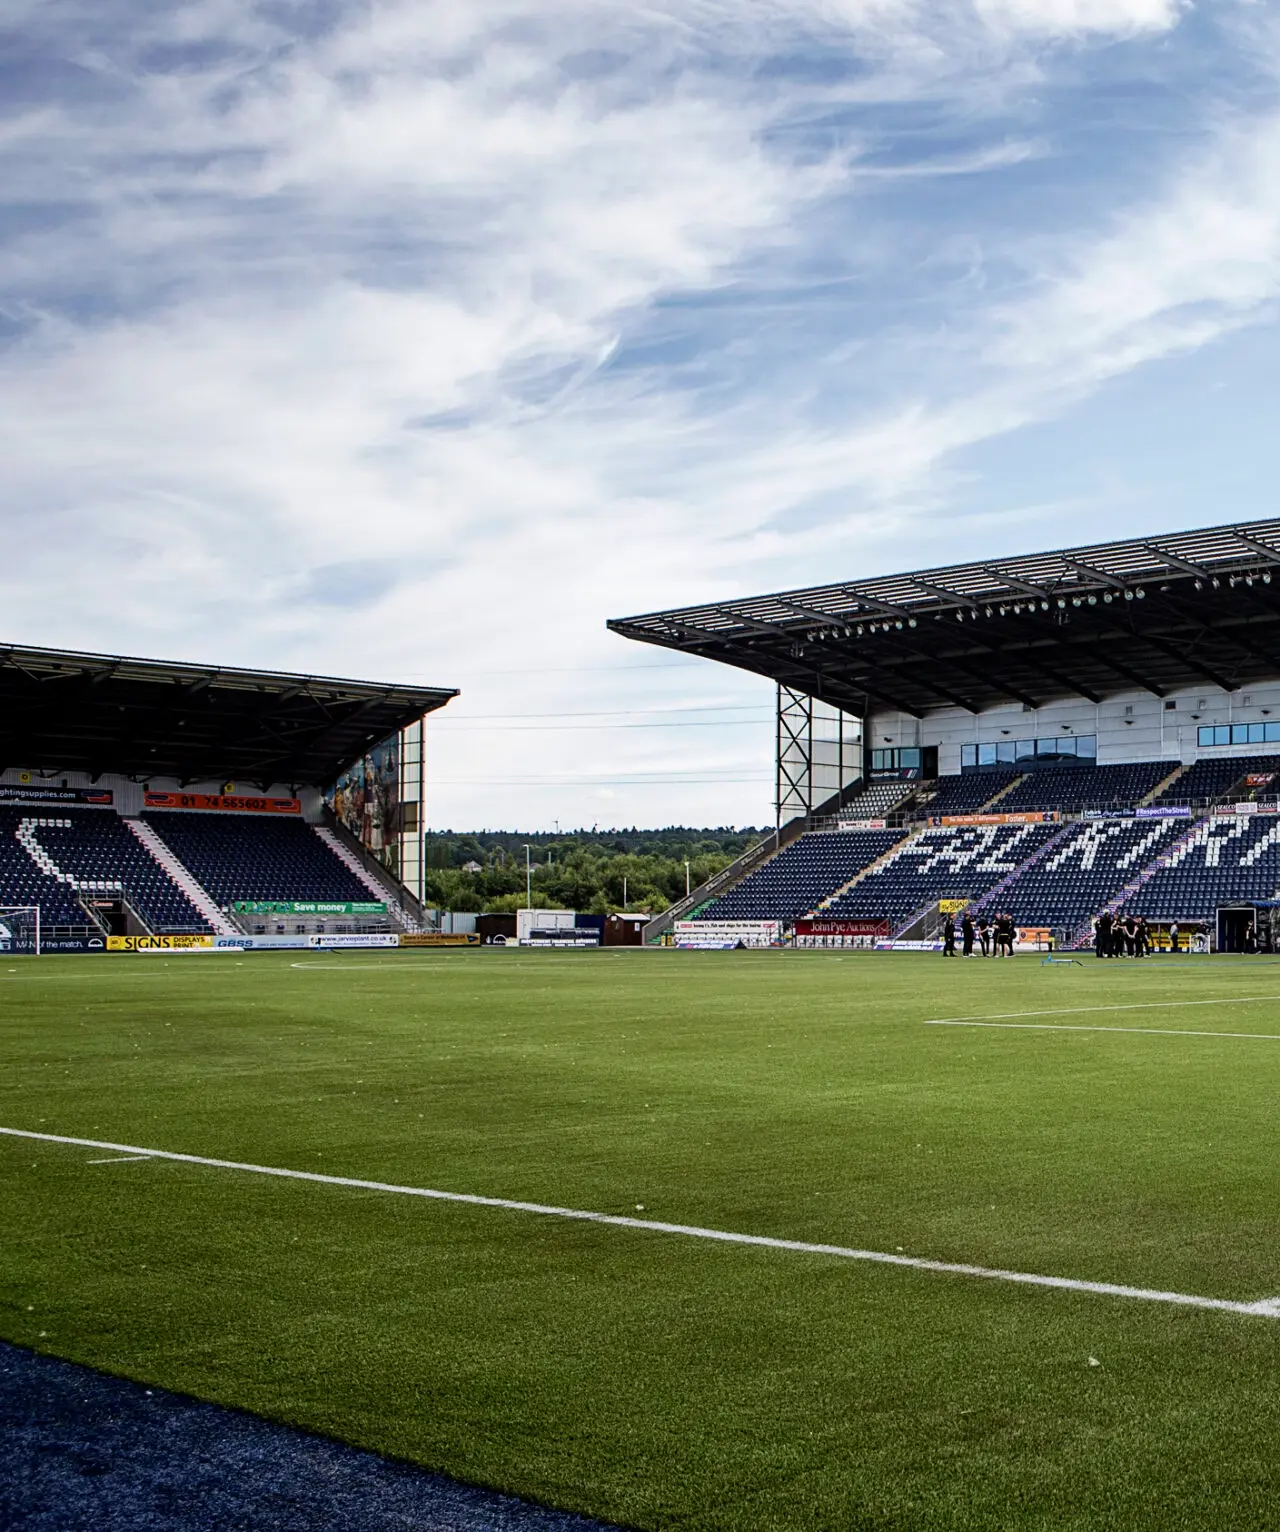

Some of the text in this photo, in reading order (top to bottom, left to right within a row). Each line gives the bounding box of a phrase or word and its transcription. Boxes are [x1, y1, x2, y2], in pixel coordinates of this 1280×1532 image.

[1136, 807, 1189, 815] #RespectTheStreet
[294, 902, 316, 911] Save
[317, 903, 347, 912] money
[810, 922, 874, 934] John Pye Auctions
[124, 936, 170, 949] SIGNS
[217, 939, 253, 948] GBSS
[320, 935, 387, 943] www.jarvieplant.co.uk
